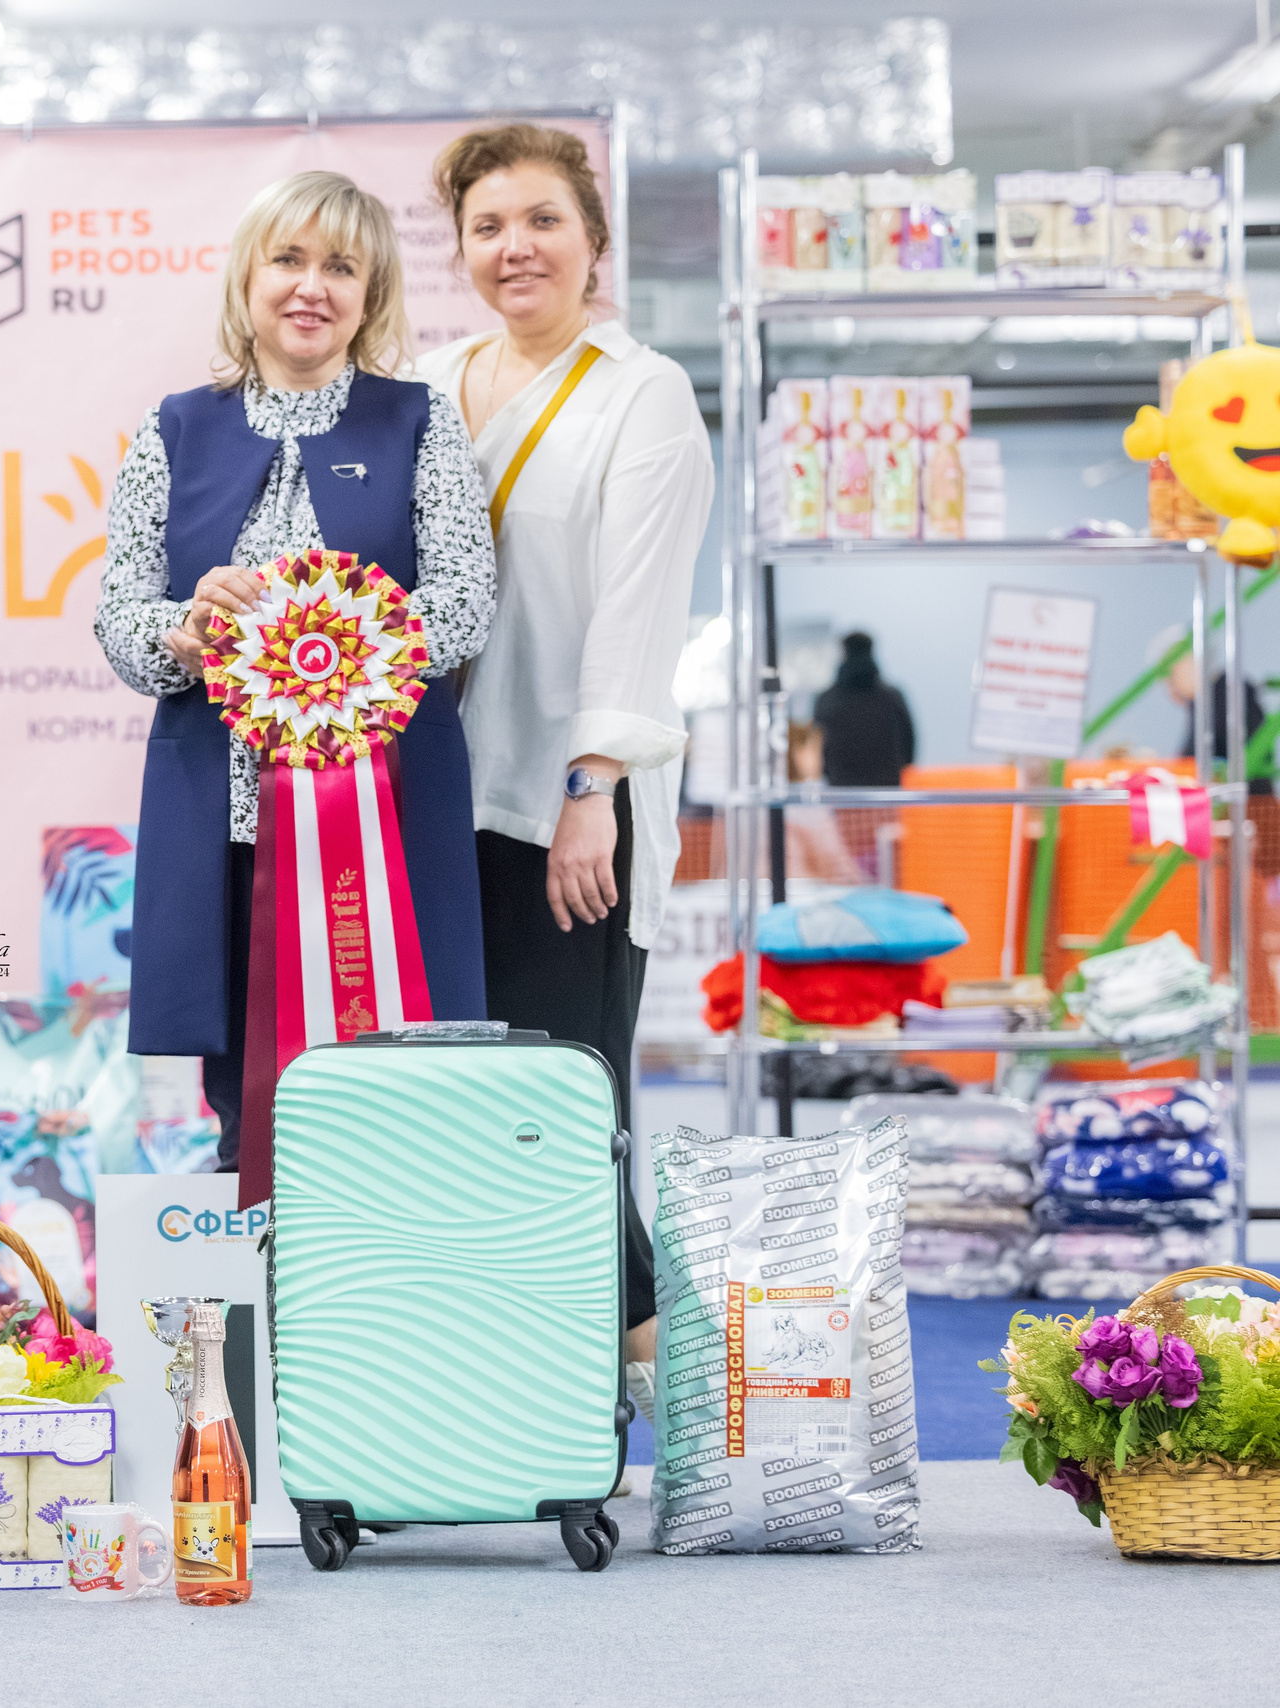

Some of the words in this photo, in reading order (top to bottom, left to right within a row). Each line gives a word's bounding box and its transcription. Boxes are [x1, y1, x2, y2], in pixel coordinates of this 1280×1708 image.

[50, 208, 152, 237] PETS
[50, 246, 230, 276] PRODUC
[52, 287, 106, 313] RU
[26, 716, 116, 742] КОРМ
[765, 1144, 838, 1167] ЗООМЕНЮ
[765, 1172, 837, 1193] ЗООМЕНЮ
[660, 1193, 730, 1218] ЗООМЕНЮ
[764, 1199, 836, 1221] ЗООМЕНЮ
[157, 1205, 267, 1242] СФЕР
[662, 1218, 730, 1246] ЗООМЕНЮ
[762, 1224, 836, 1249] ЗООМЕНЮ
[761, 1251, 836, 1277] ЗООМЕНЮ
[768, 1287, 832, 1298] ЗООМЕНЮ
[670, 1302, 727, 1329] ЗООМЕНЮ
[668, 1330, 727, 1359] ЗООМЕНЮ
[668, 1360, 727, 1386] ЗООМЕНЮ
[729, 1284, 743, 1456] ПРОФЕССИОНАЛ
[668, 1389, 727, 1415] ЗООМЕНЮ
[746, 1388, 808, 1397] УНИВЕРСАЛ
[668, 1417, 727, 1444] ЗООМЕНЮ
[668, 1446, 727, 1473] ЗООМЕНЮ
[667, 1475, 730, 1500] ЗООМЕНЮ
[765, 1475, 840, 1503] ЗООМЕНЮ
[664, 1504, 730, 1529] ЗООМЕНЮ
[766, 1503, 841, 1531] ЗООМЕНЮ
